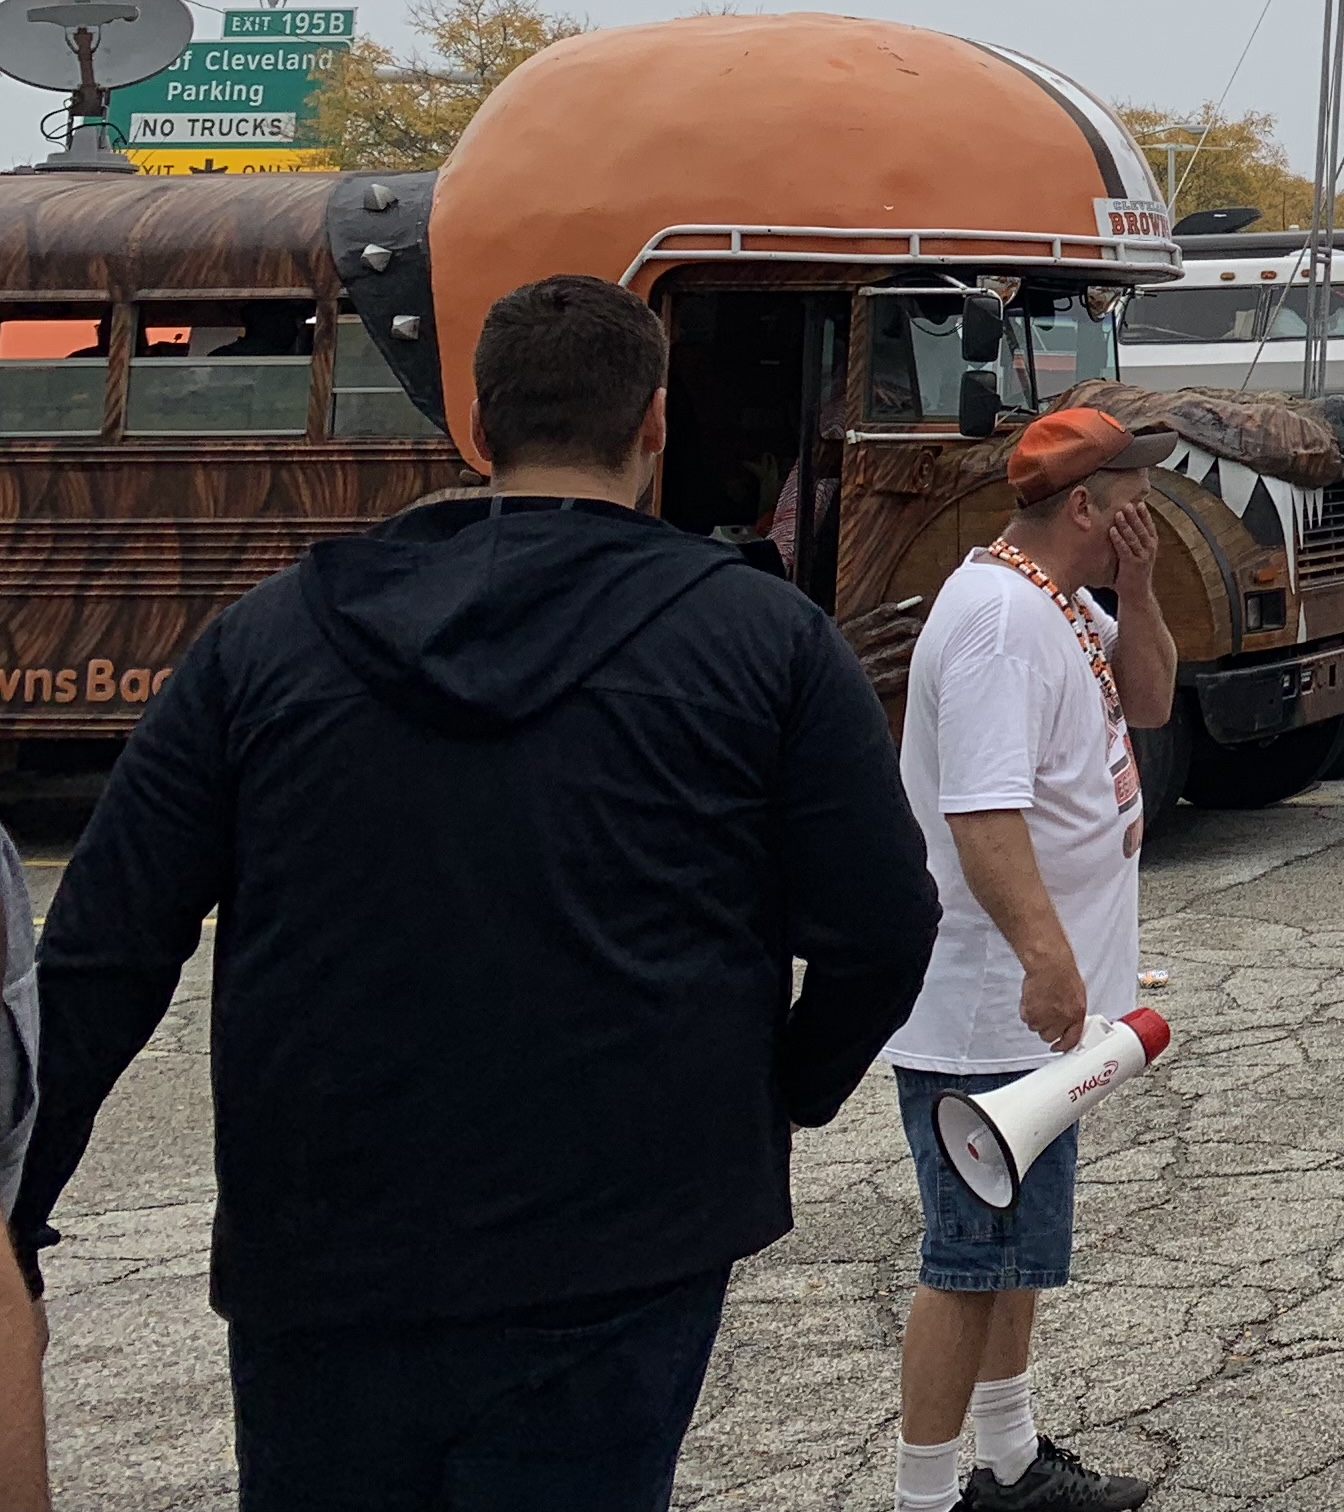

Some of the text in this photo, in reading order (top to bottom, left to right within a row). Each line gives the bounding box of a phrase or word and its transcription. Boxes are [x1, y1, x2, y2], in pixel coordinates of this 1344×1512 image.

[231, 12, 345, 35] EXIT 195B
[205, 49, 333, 71] Cleveland
[167, 81, 264, 107] Parking
[142, 117, 283, 137] NO TRUCKS
[1067, 1075, 1098, 1103] PYLE
